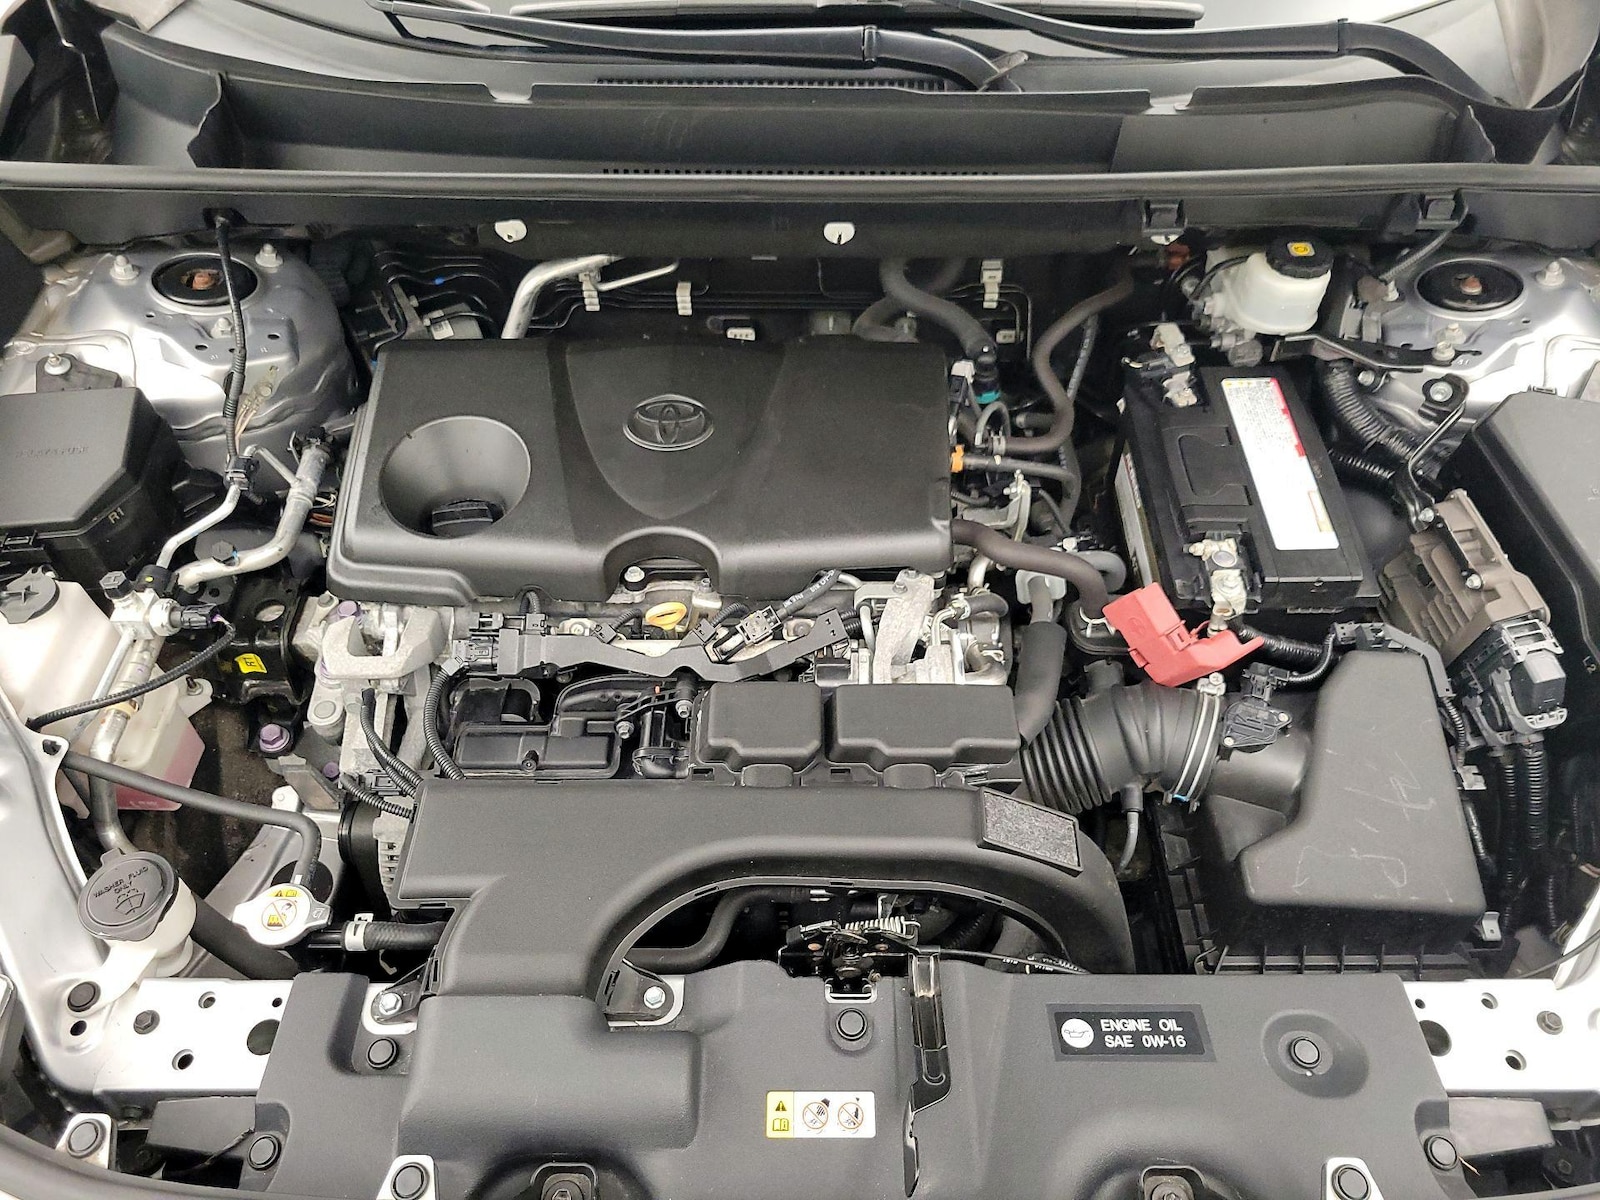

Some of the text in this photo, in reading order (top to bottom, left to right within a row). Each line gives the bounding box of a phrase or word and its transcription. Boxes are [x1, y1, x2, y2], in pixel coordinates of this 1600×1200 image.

[108, 507, 125, 524] R1
[1582, 655, 1596, 674] L2
[93, 866, 149, 898] WASHER FLUID
[114, 881, 132, 894] ONLY
[1100, 1018, 1183, 1032] ENGINE OIL
[1105, 1035, 1187, 1048] SAE 0W-16
